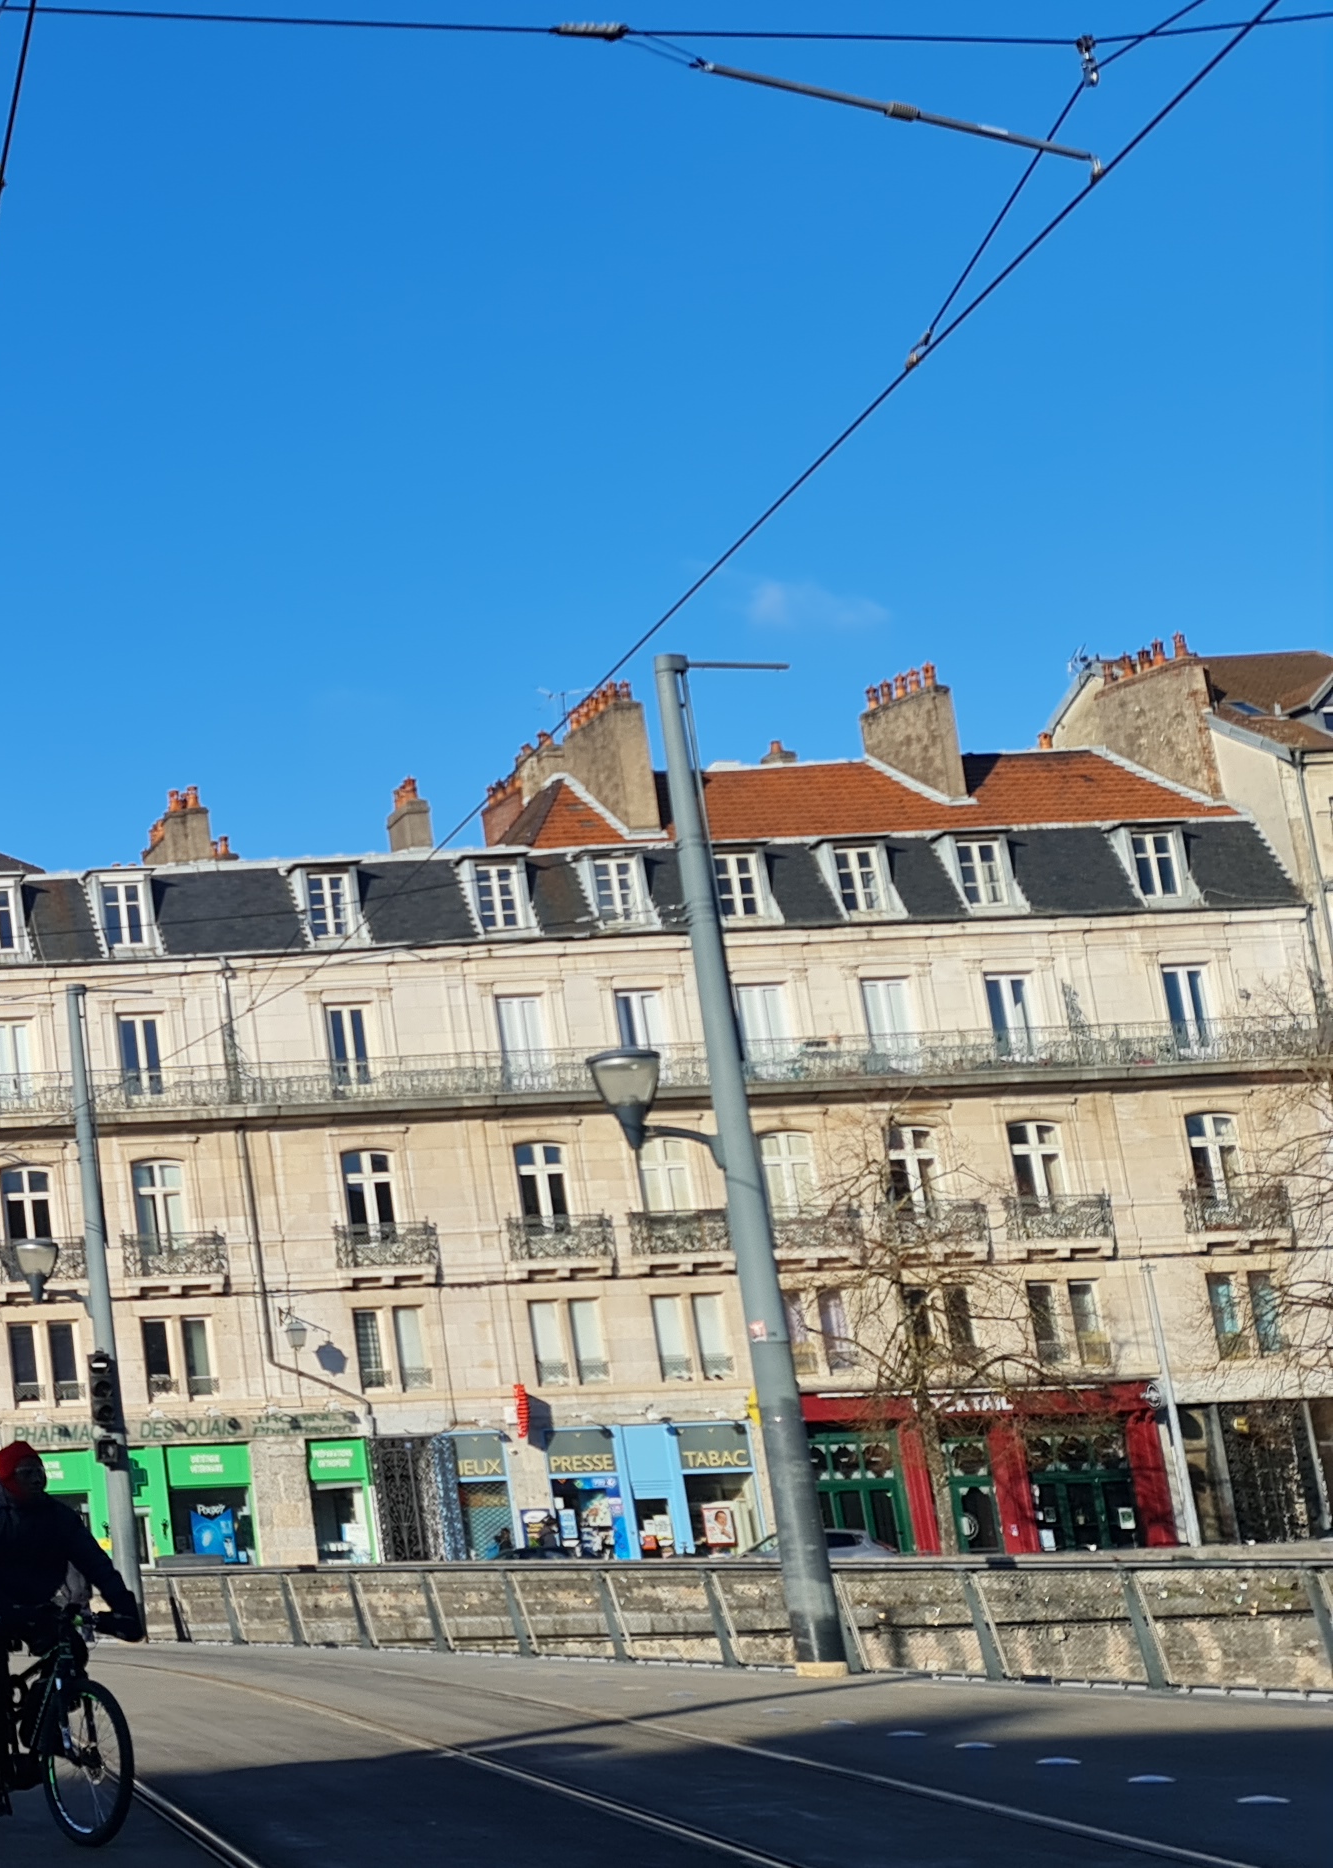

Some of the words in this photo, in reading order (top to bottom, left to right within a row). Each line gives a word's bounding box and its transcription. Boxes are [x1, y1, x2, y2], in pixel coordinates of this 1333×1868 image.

[140, 1419, 175, 1439] DES
[184, 1414, 239, 1438] QUAIS
[549, 1454, 614, 1472] PRESSE
[682, 1448, 749, 1468] TABAC
